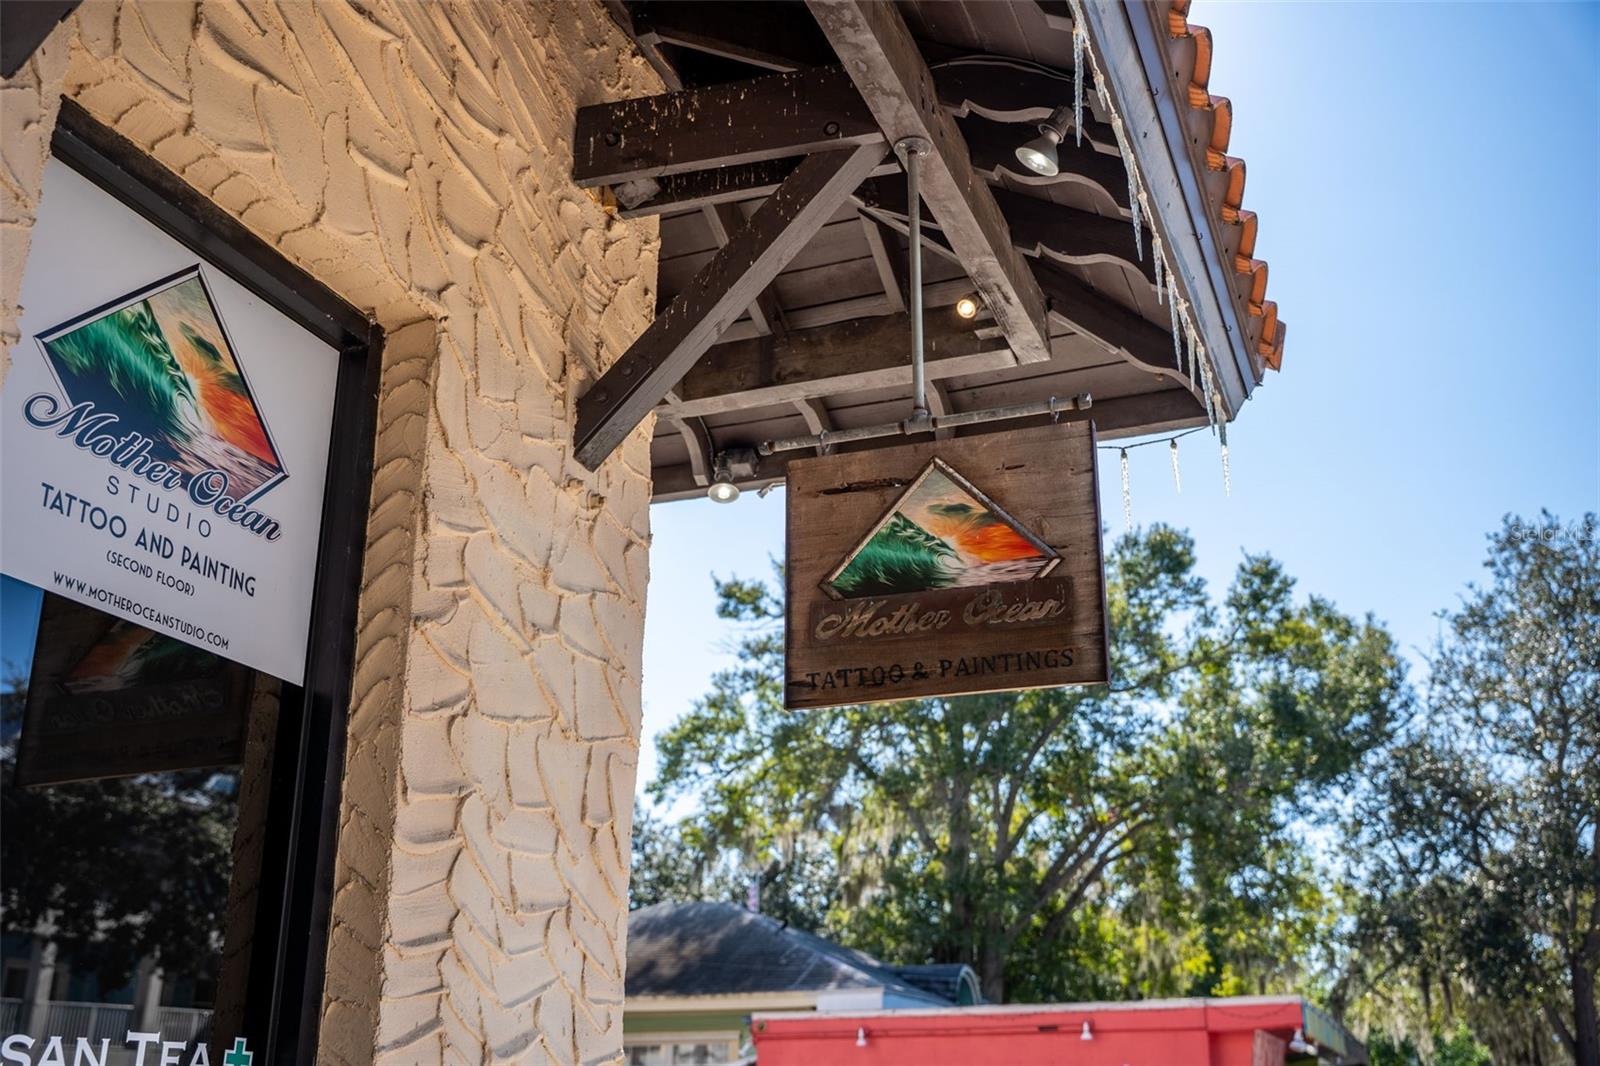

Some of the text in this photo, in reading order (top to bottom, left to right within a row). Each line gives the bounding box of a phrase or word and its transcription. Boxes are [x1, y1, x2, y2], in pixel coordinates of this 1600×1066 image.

[24, 393, 282, 542] Mother Ocean
[106, 475, 212, 538] STUDIO
[41, 482, 256, 597] TATTOO AND PAINTING
[106, 550, 195, 597] (SECOND FLOOR)
[53, 571, 229, 650] WWW.MOTHEROCEANSTUDIO.COM
[815, 588, 1065, 640] Mother Ocean
[806, 648, 1074, 691] TATTOO & PAINTINGS
